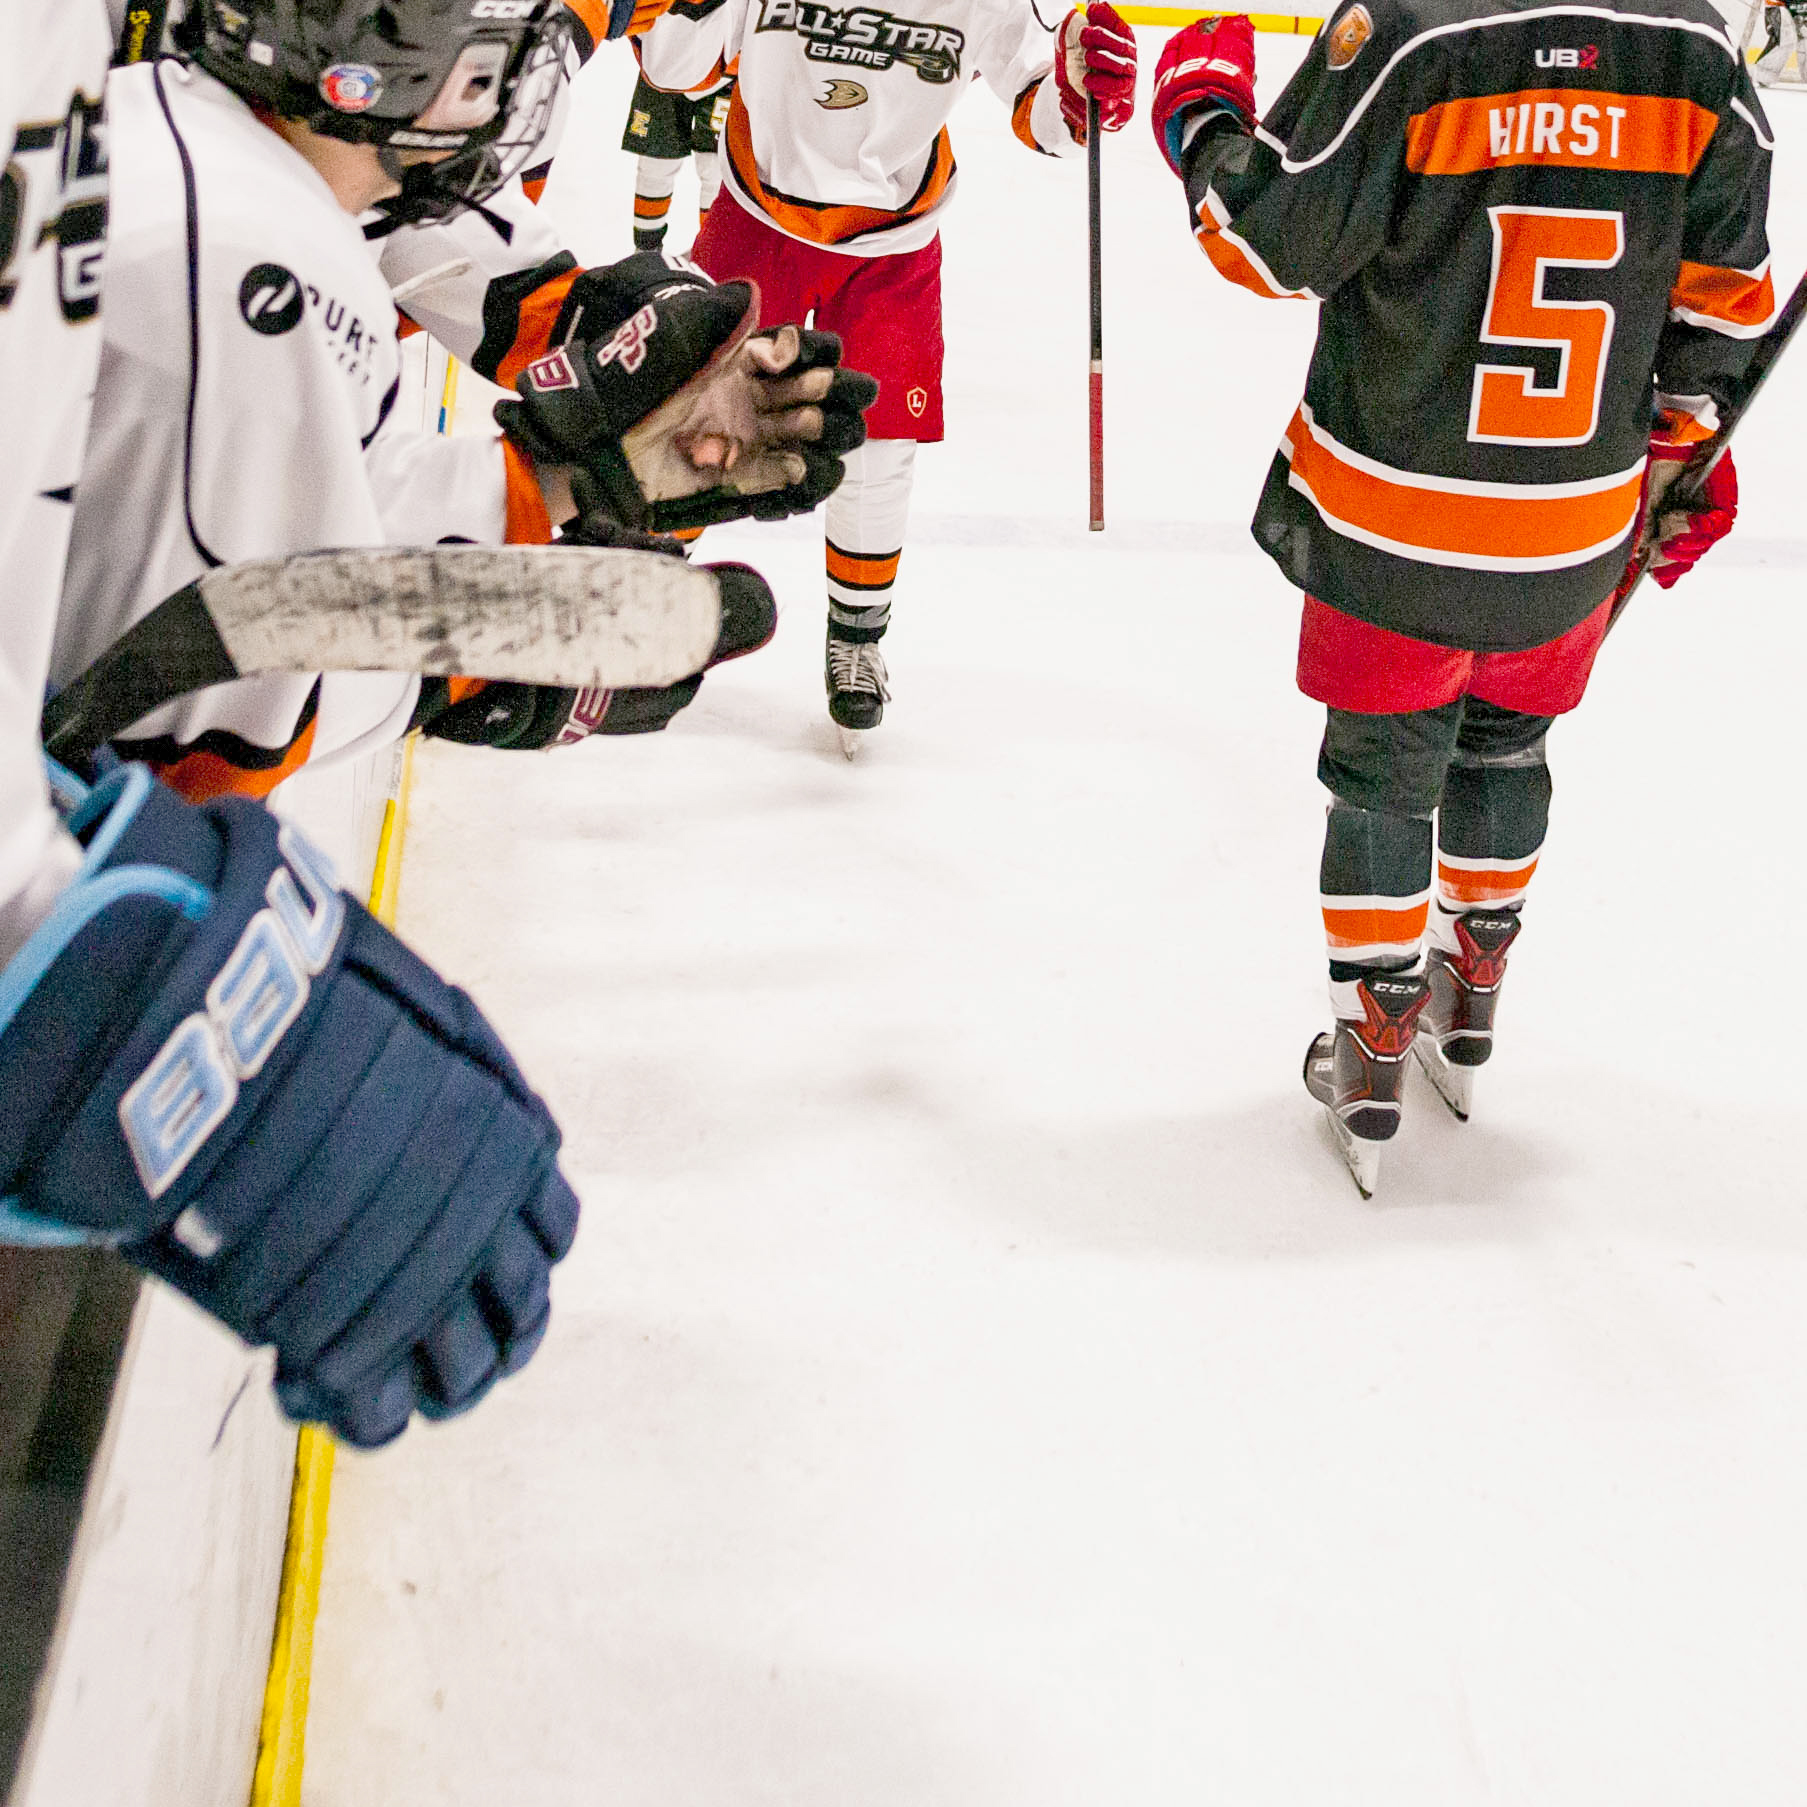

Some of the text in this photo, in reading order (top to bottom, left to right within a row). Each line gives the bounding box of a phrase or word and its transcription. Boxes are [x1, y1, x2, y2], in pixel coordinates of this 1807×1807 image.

[808, 41, 892, 67] GAME
[1489, 102, 1627, 160] HIRST
[1466, 205, 1627, 448] 5
[1468, 919, 1513, 930] CCM
[1373, 982, 1422, 994] CCM
